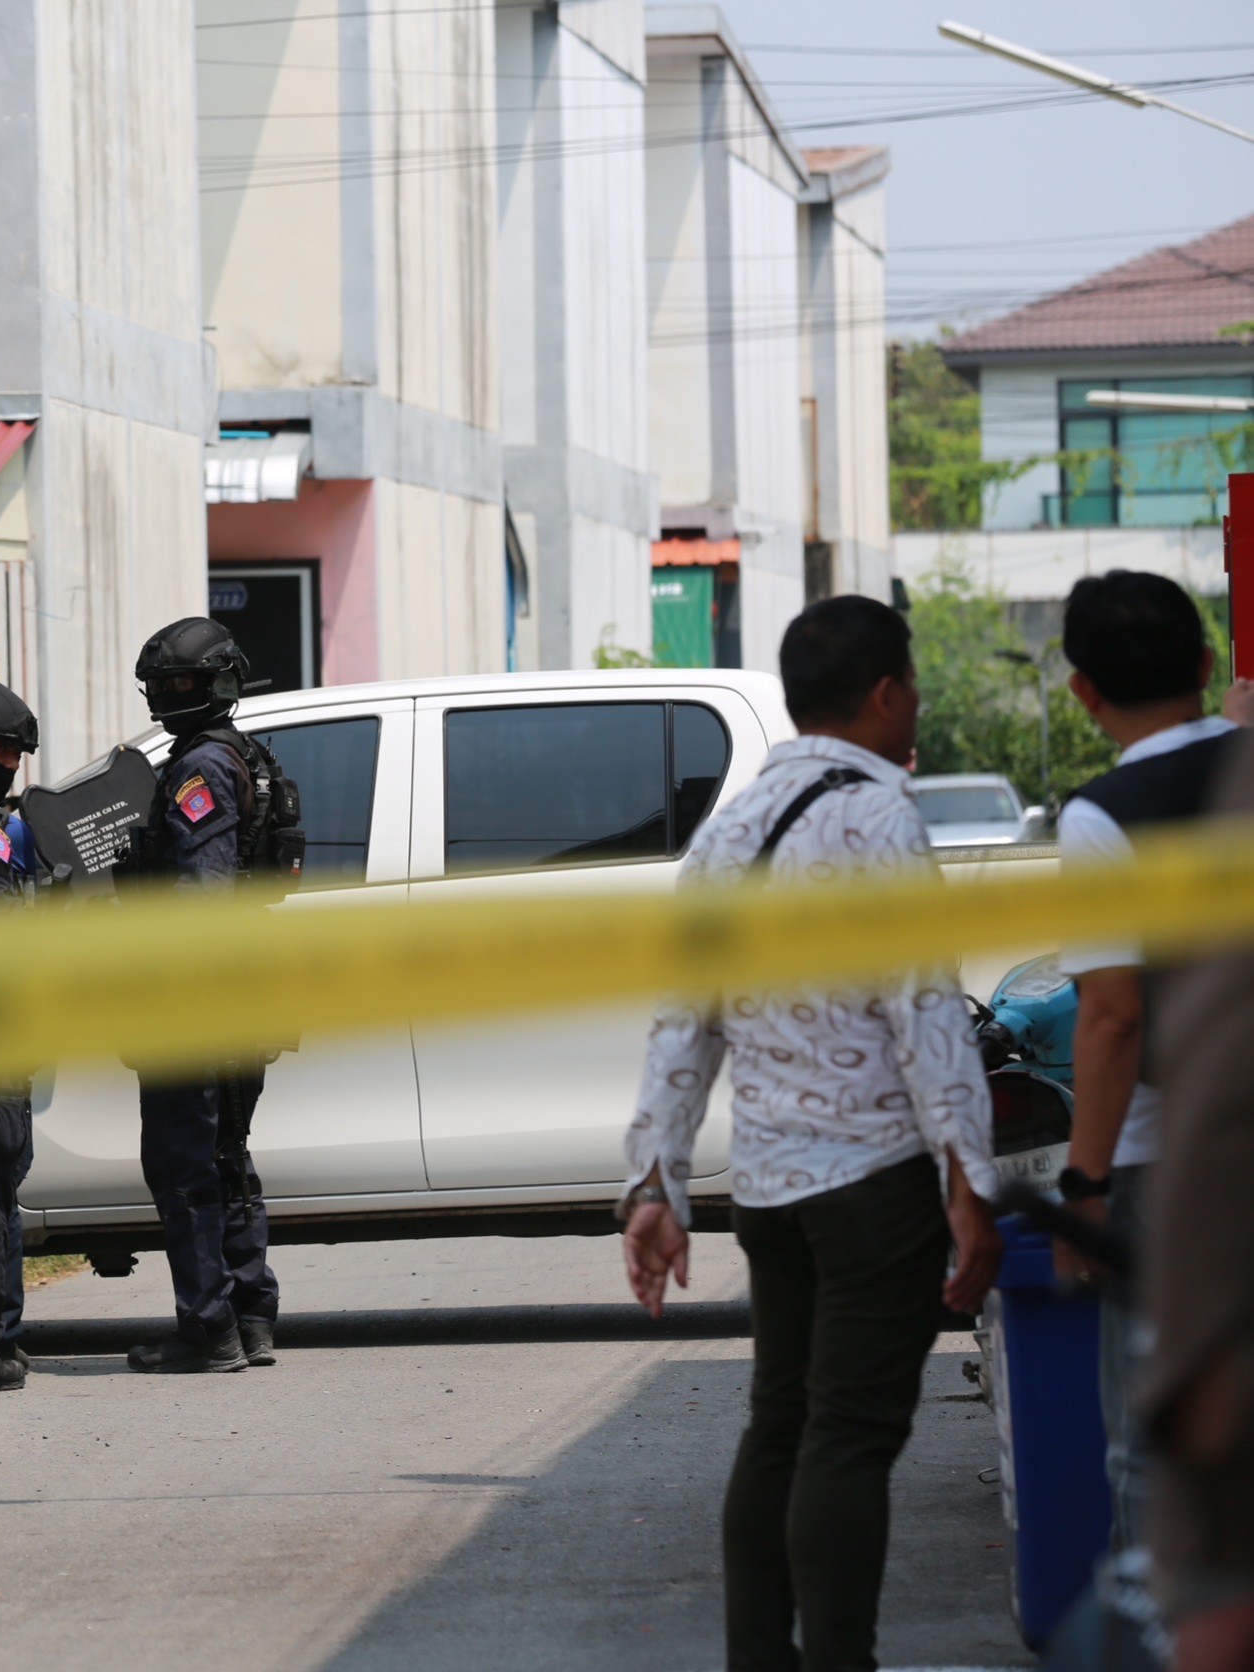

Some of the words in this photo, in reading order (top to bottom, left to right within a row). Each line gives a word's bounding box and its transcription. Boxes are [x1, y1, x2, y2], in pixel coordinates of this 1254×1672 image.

[102, 807, 112, 815] CO
[70, 823, 96, 837] SHIELD
[74, 831, 97, 845] MODEL
[115, 812, 140, 827] SHIELD
[77, 838, 103, 852] SERIAL
[96, 841, 114, 853] DATE
[83, 856, 98, 867] EXP
